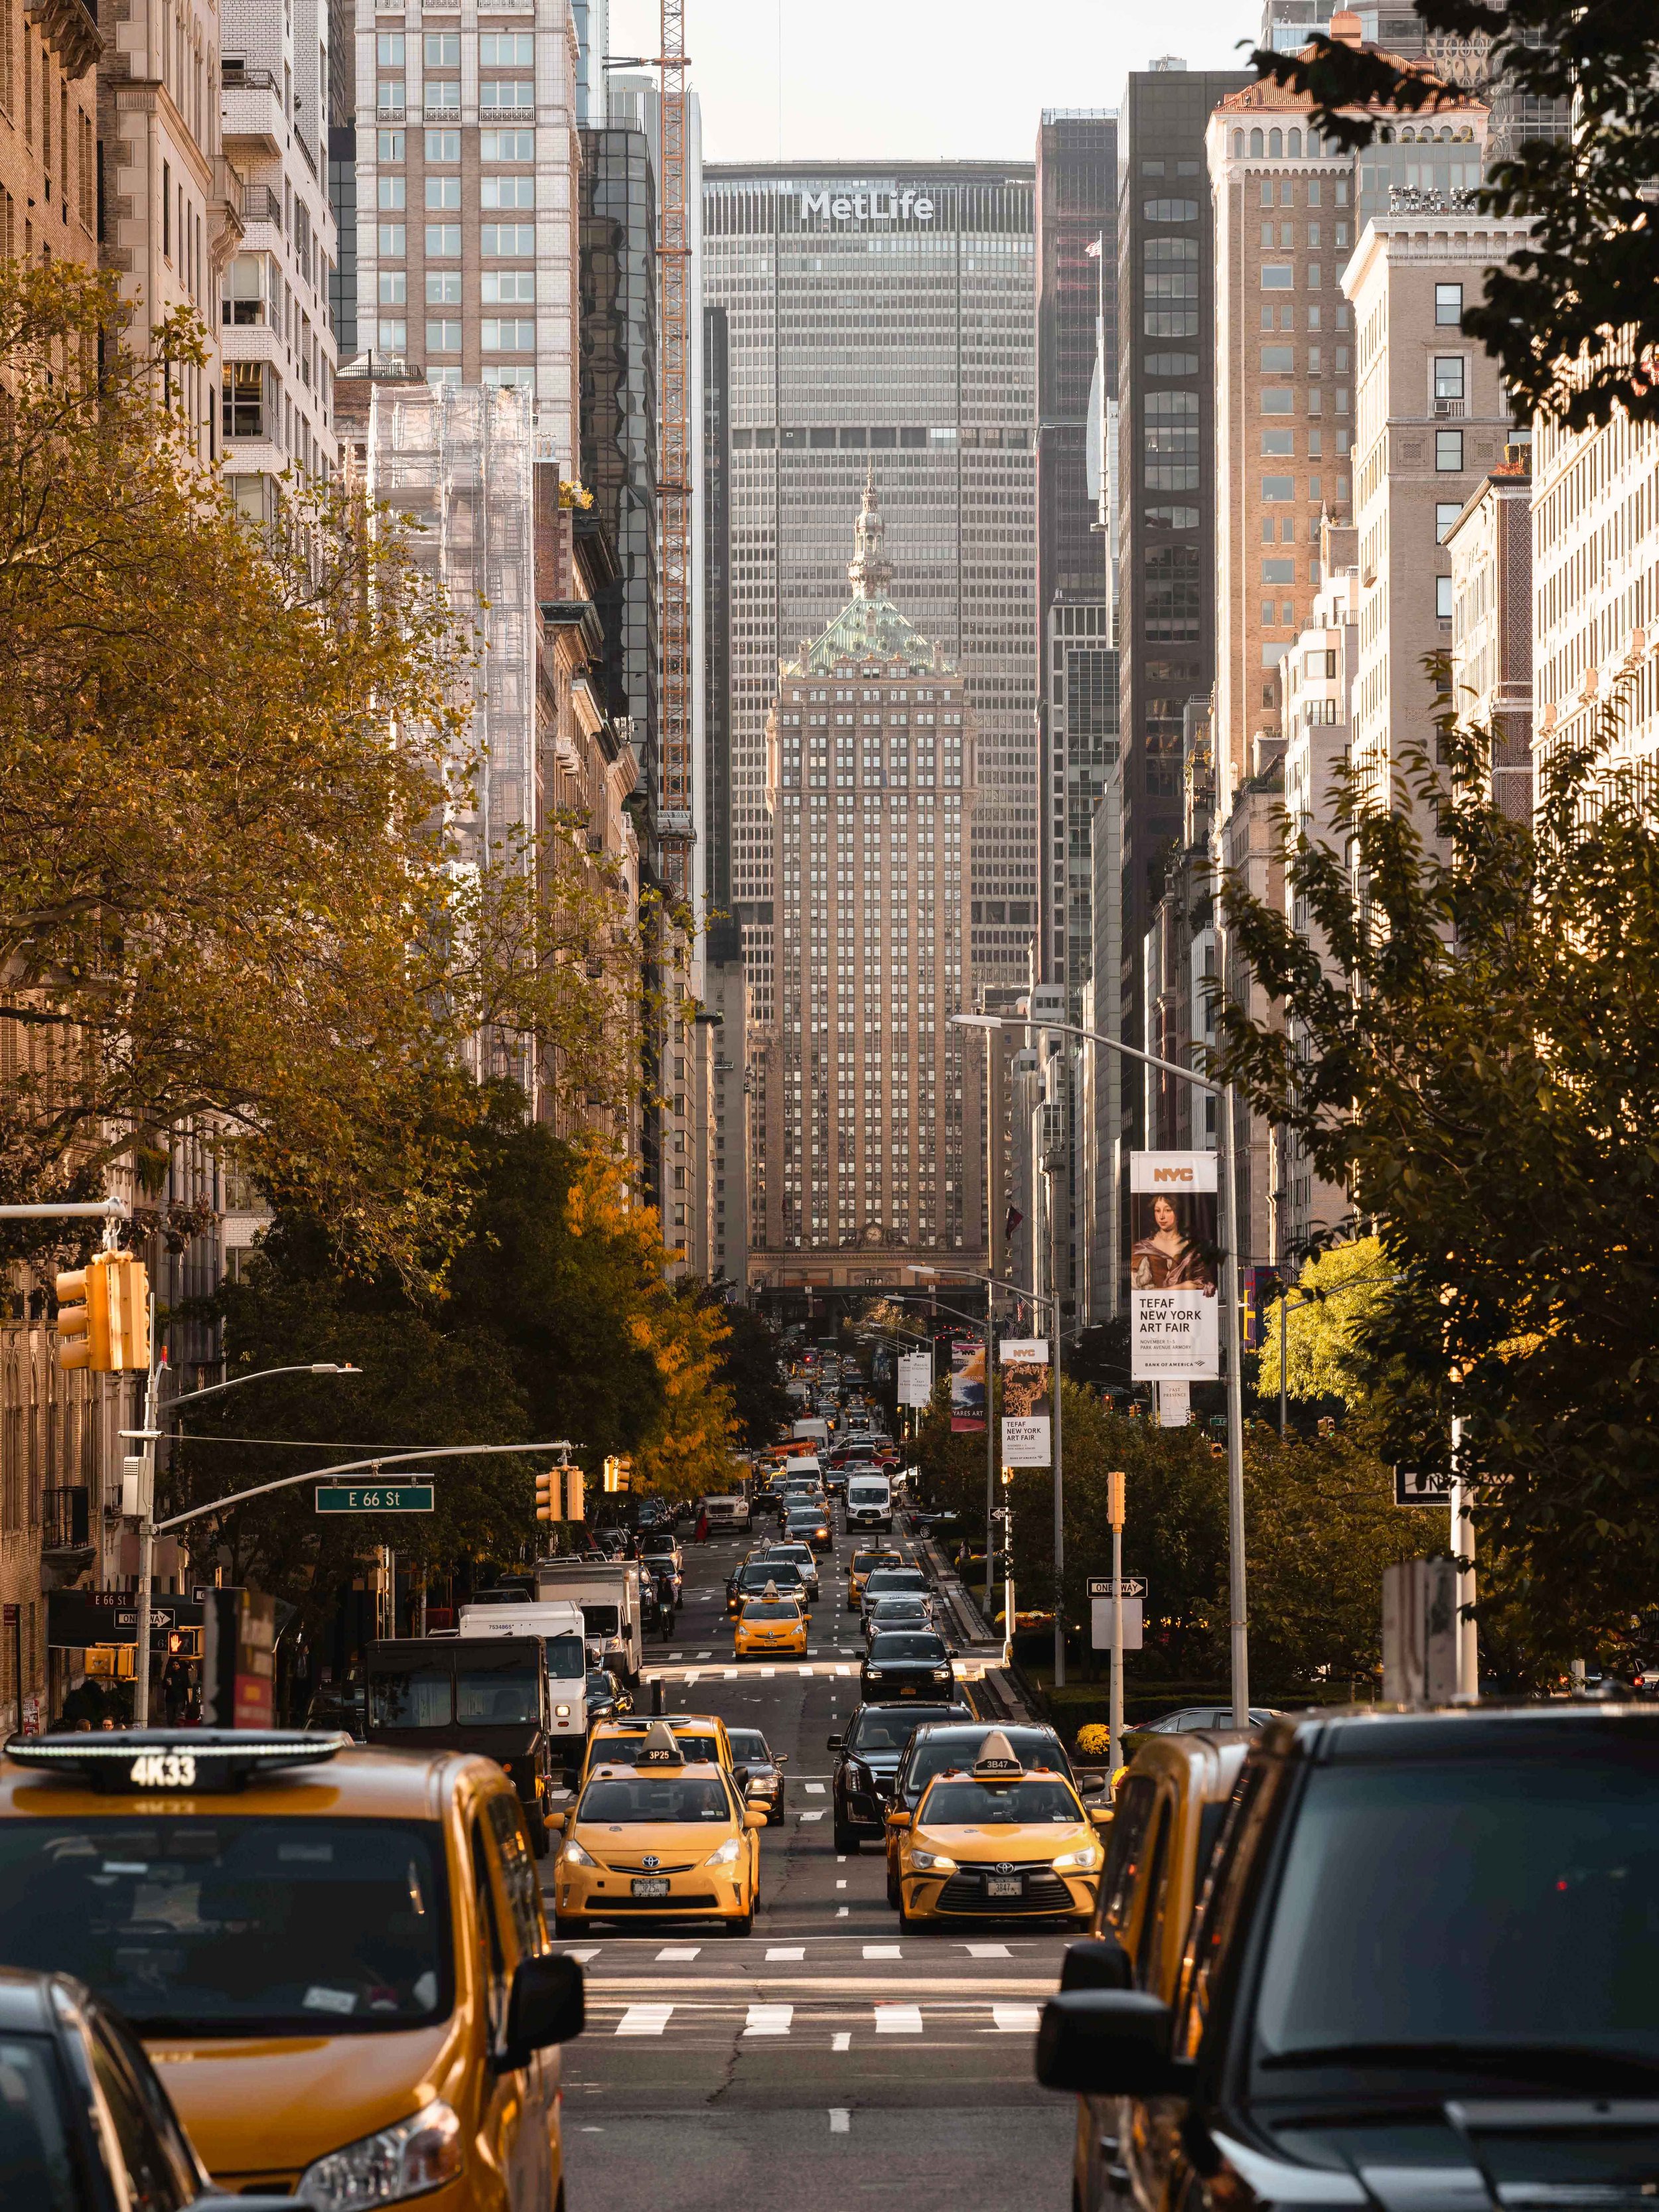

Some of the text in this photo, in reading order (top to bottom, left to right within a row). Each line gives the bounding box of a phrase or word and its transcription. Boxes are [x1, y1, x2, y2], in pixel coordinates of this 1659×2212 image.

[801, 190, 934, 220] MetLife
[1154, 1168, 1193, 1182] NYC
[1139, 1298, 1175, 1308] TEFAF
[1140, 1310, 1202, 1320] NEW YORK
[1139, 1323, 1190, 1332] ART FAIR
[349, 1491, 400, 1507] E 66 St
[95, 1595, 126, 1605] E 66 St
[649, 1751, 670, 1760] 3P25
[130, 1755, 196, 1787] 4K33
